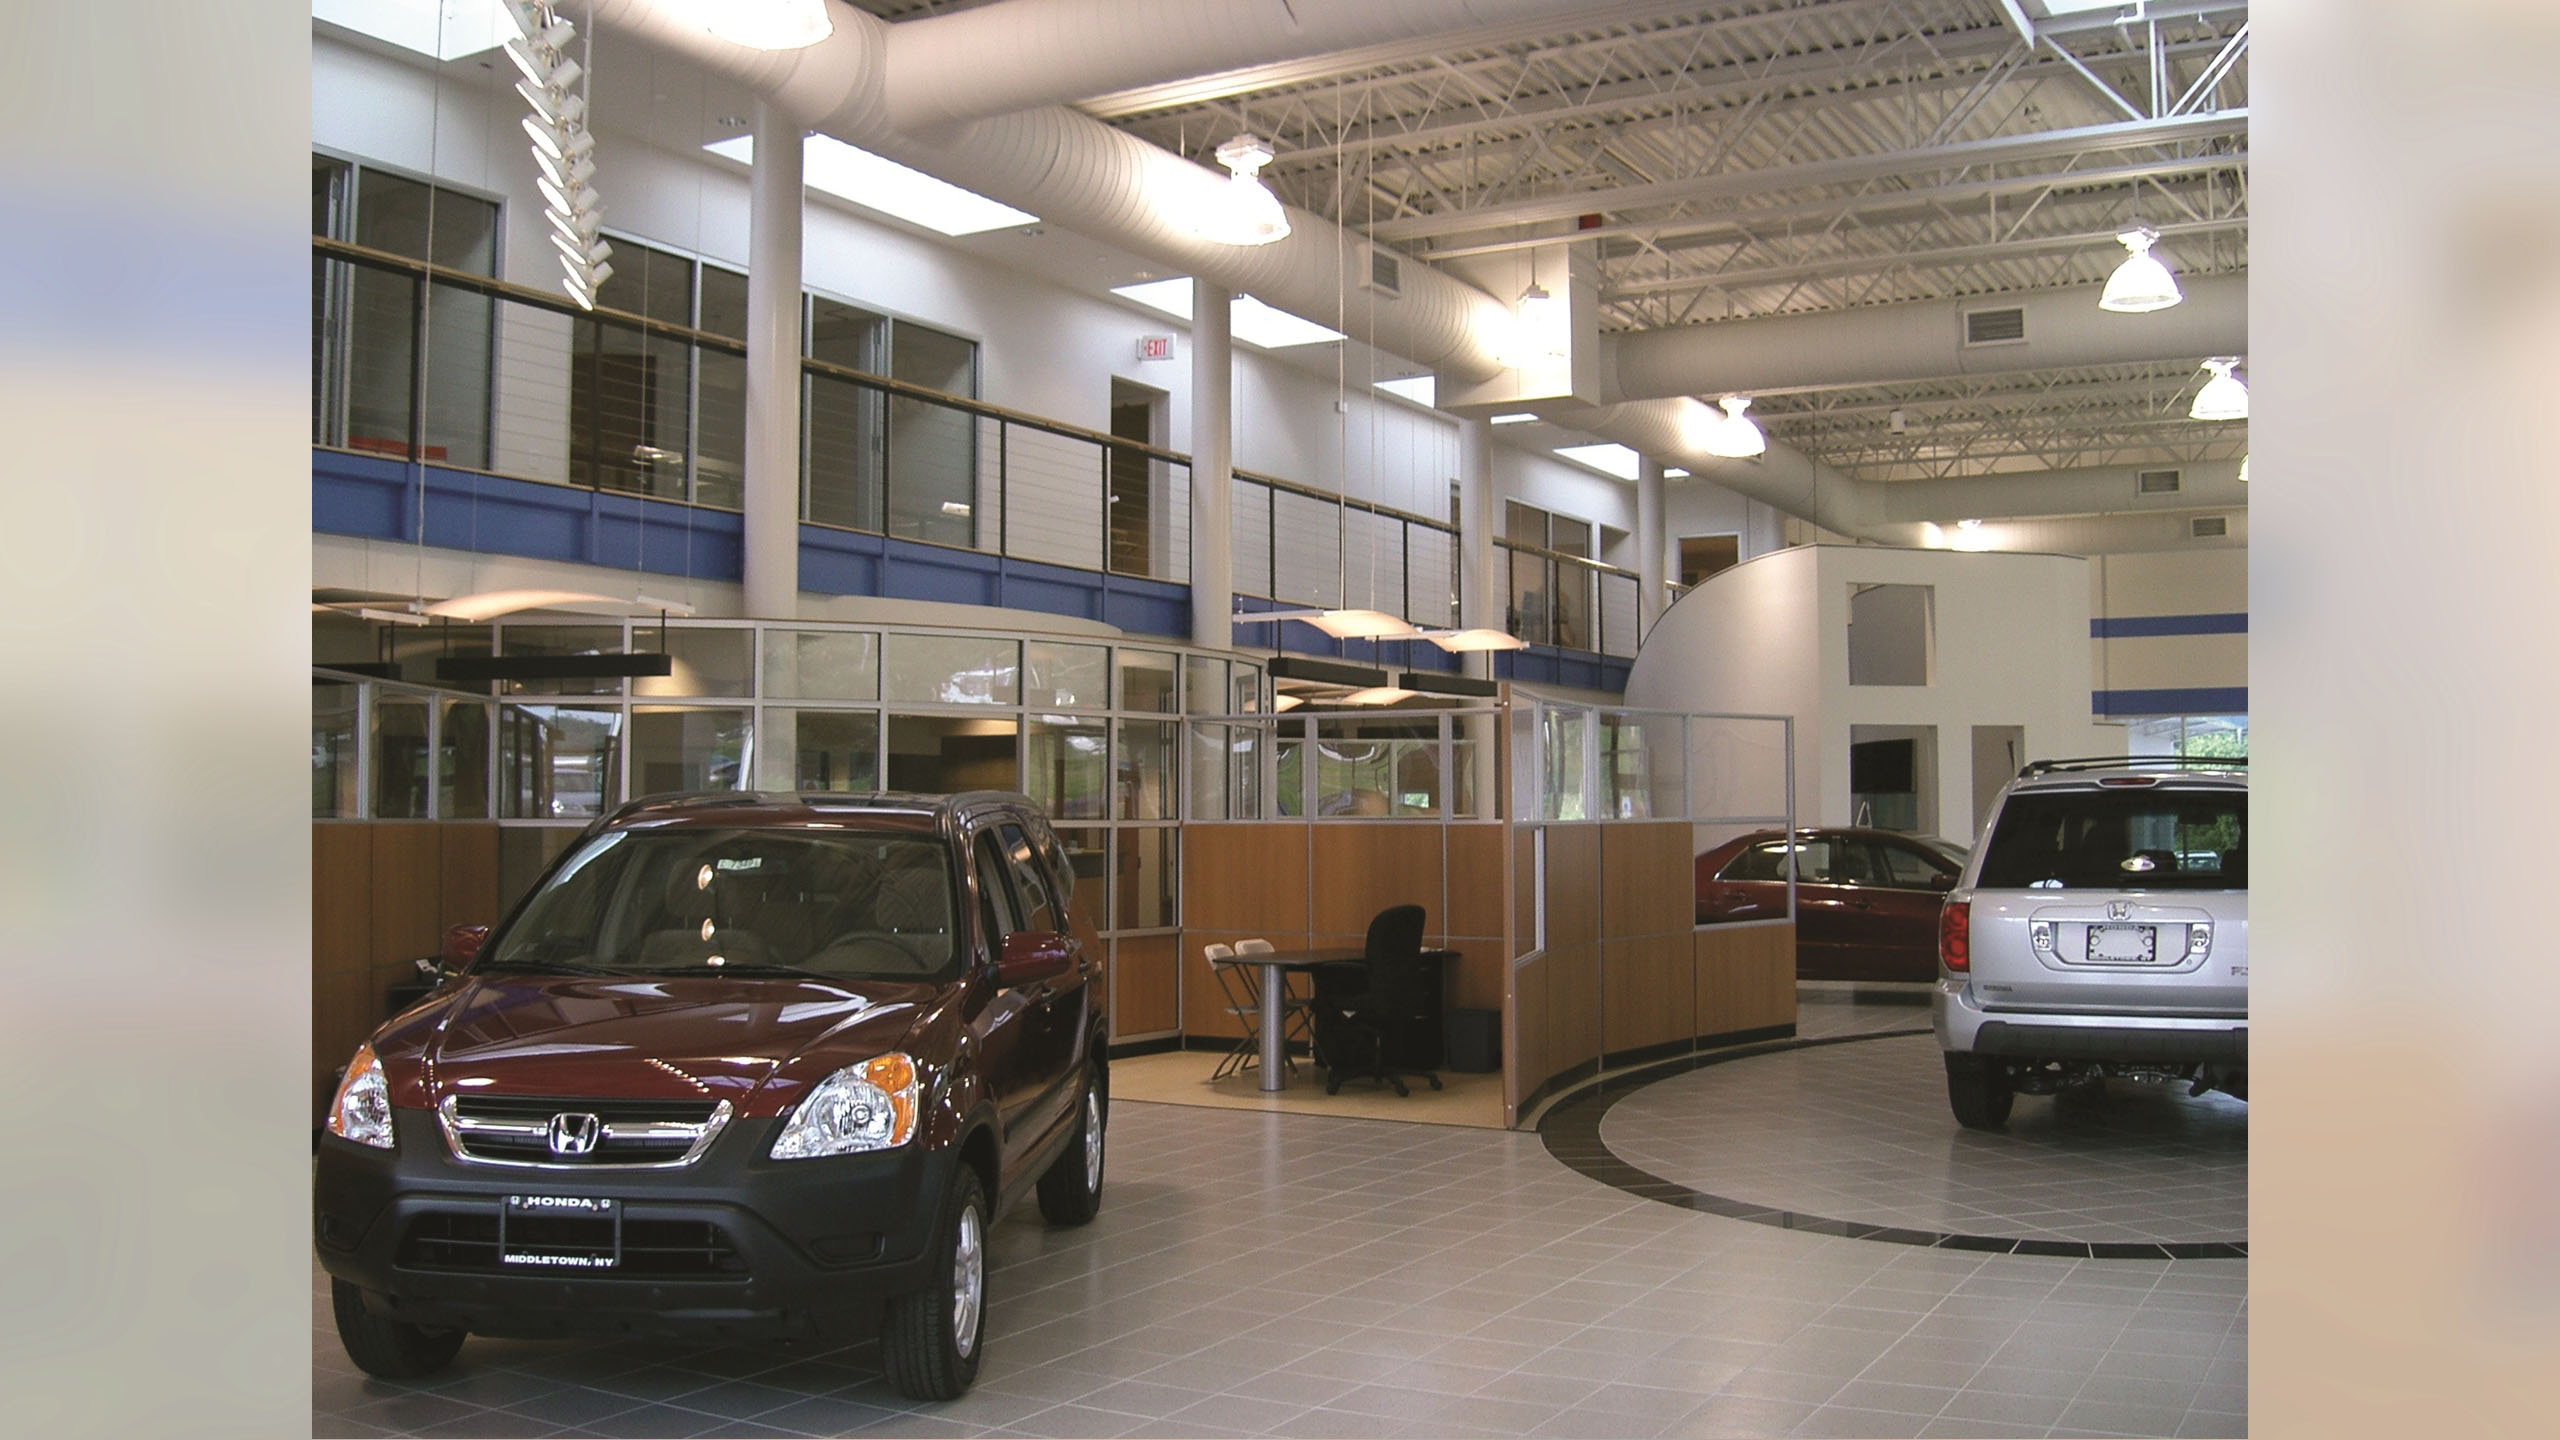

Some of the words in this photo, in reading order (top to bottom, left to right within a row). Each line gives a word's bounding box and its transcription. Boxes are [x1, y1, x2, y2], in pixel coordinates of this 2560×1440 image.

[1147, 338, 1168, 357] EXIT
[527, 1196, 593, 1208] HONDA
[504, 1254, 592, 1267] MIDDLETOWN,
[595, 1258, 614, 1267] NY
